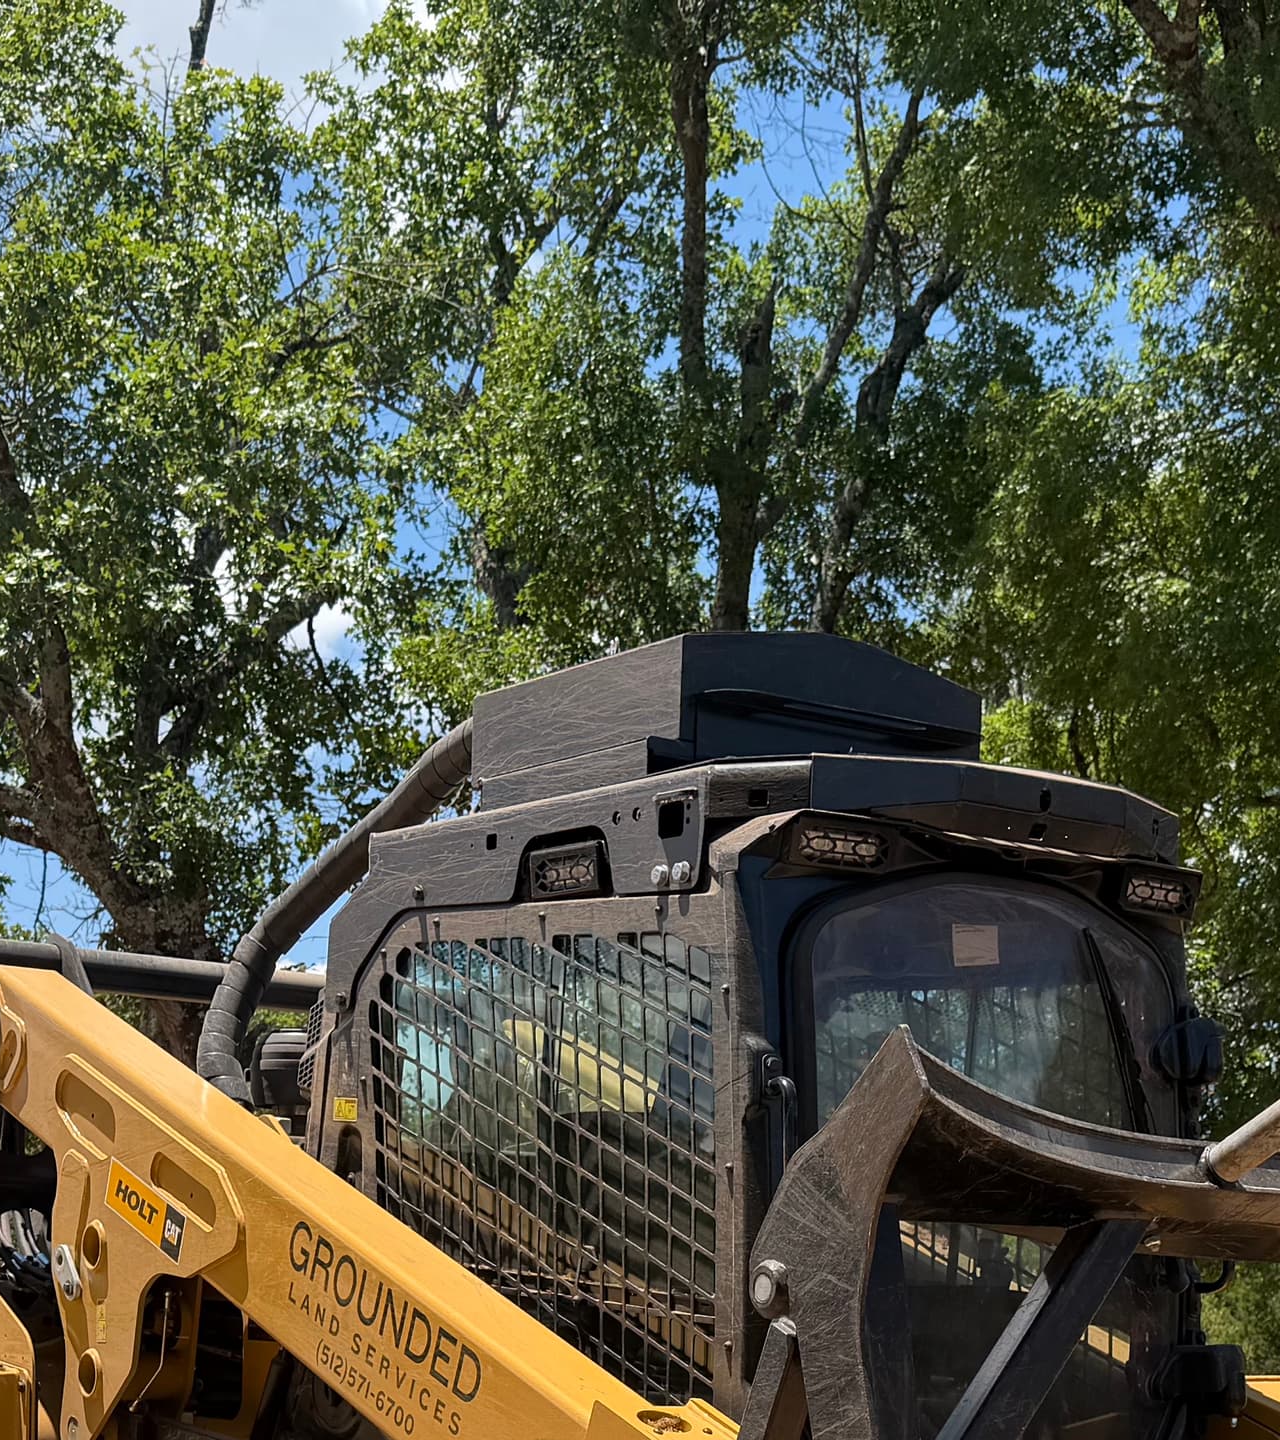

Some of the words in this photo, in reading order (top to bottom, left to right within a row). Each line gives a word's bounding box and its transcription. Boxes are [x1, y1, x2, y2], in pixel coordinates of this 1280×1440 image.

[115, 1179, 159, 1225] HOLT
[164, 1218, 182, 1246] CAT
[288, 1282, 340, 1337] LAND
[351, 1333, 462, 1436] SERVICES
[289, 1221, 482, 1403] GROUNDED
[316, 1339, 415, 1435] (512)571-6700
